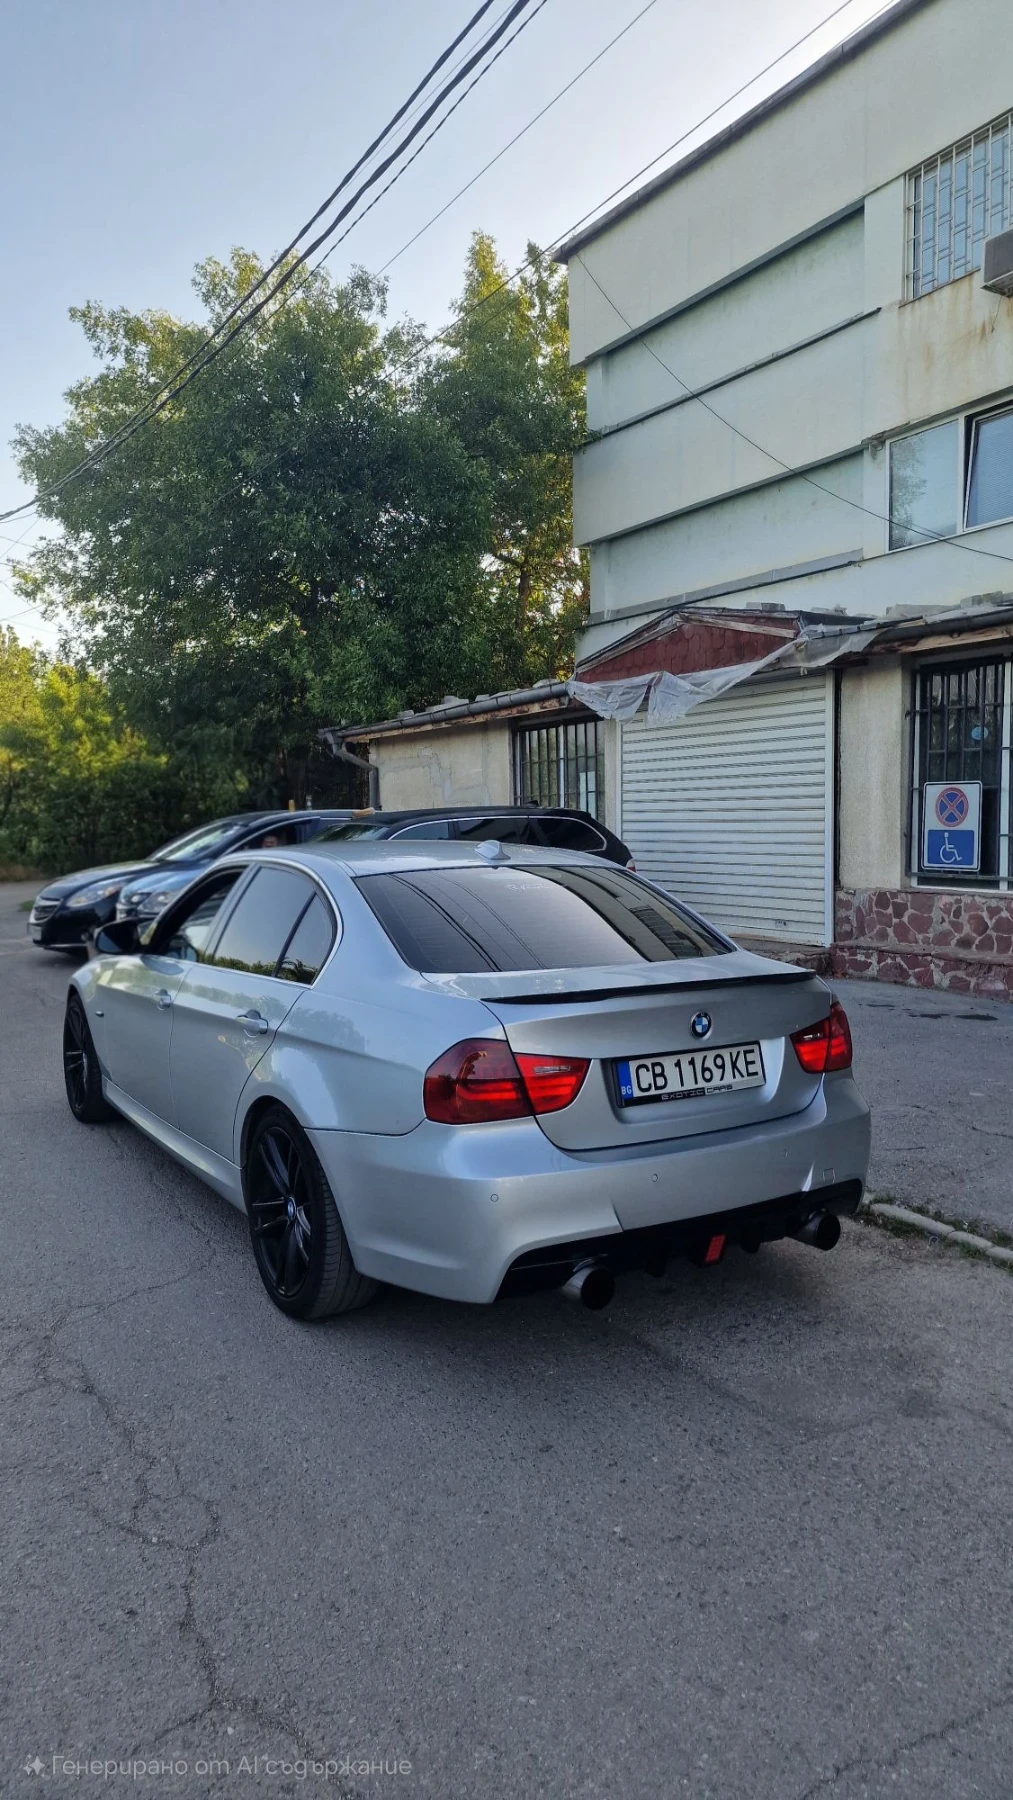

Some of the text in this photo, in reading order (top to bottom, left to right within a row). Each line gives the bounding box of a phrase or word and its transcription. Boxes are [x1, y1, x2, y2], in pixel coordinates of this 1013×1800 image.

[635, 1050, 759, 1092] CB 1169 KE
[621, 1085, 632, 1095] BG
[661, 1089, 704, 1100] EXOTIC
